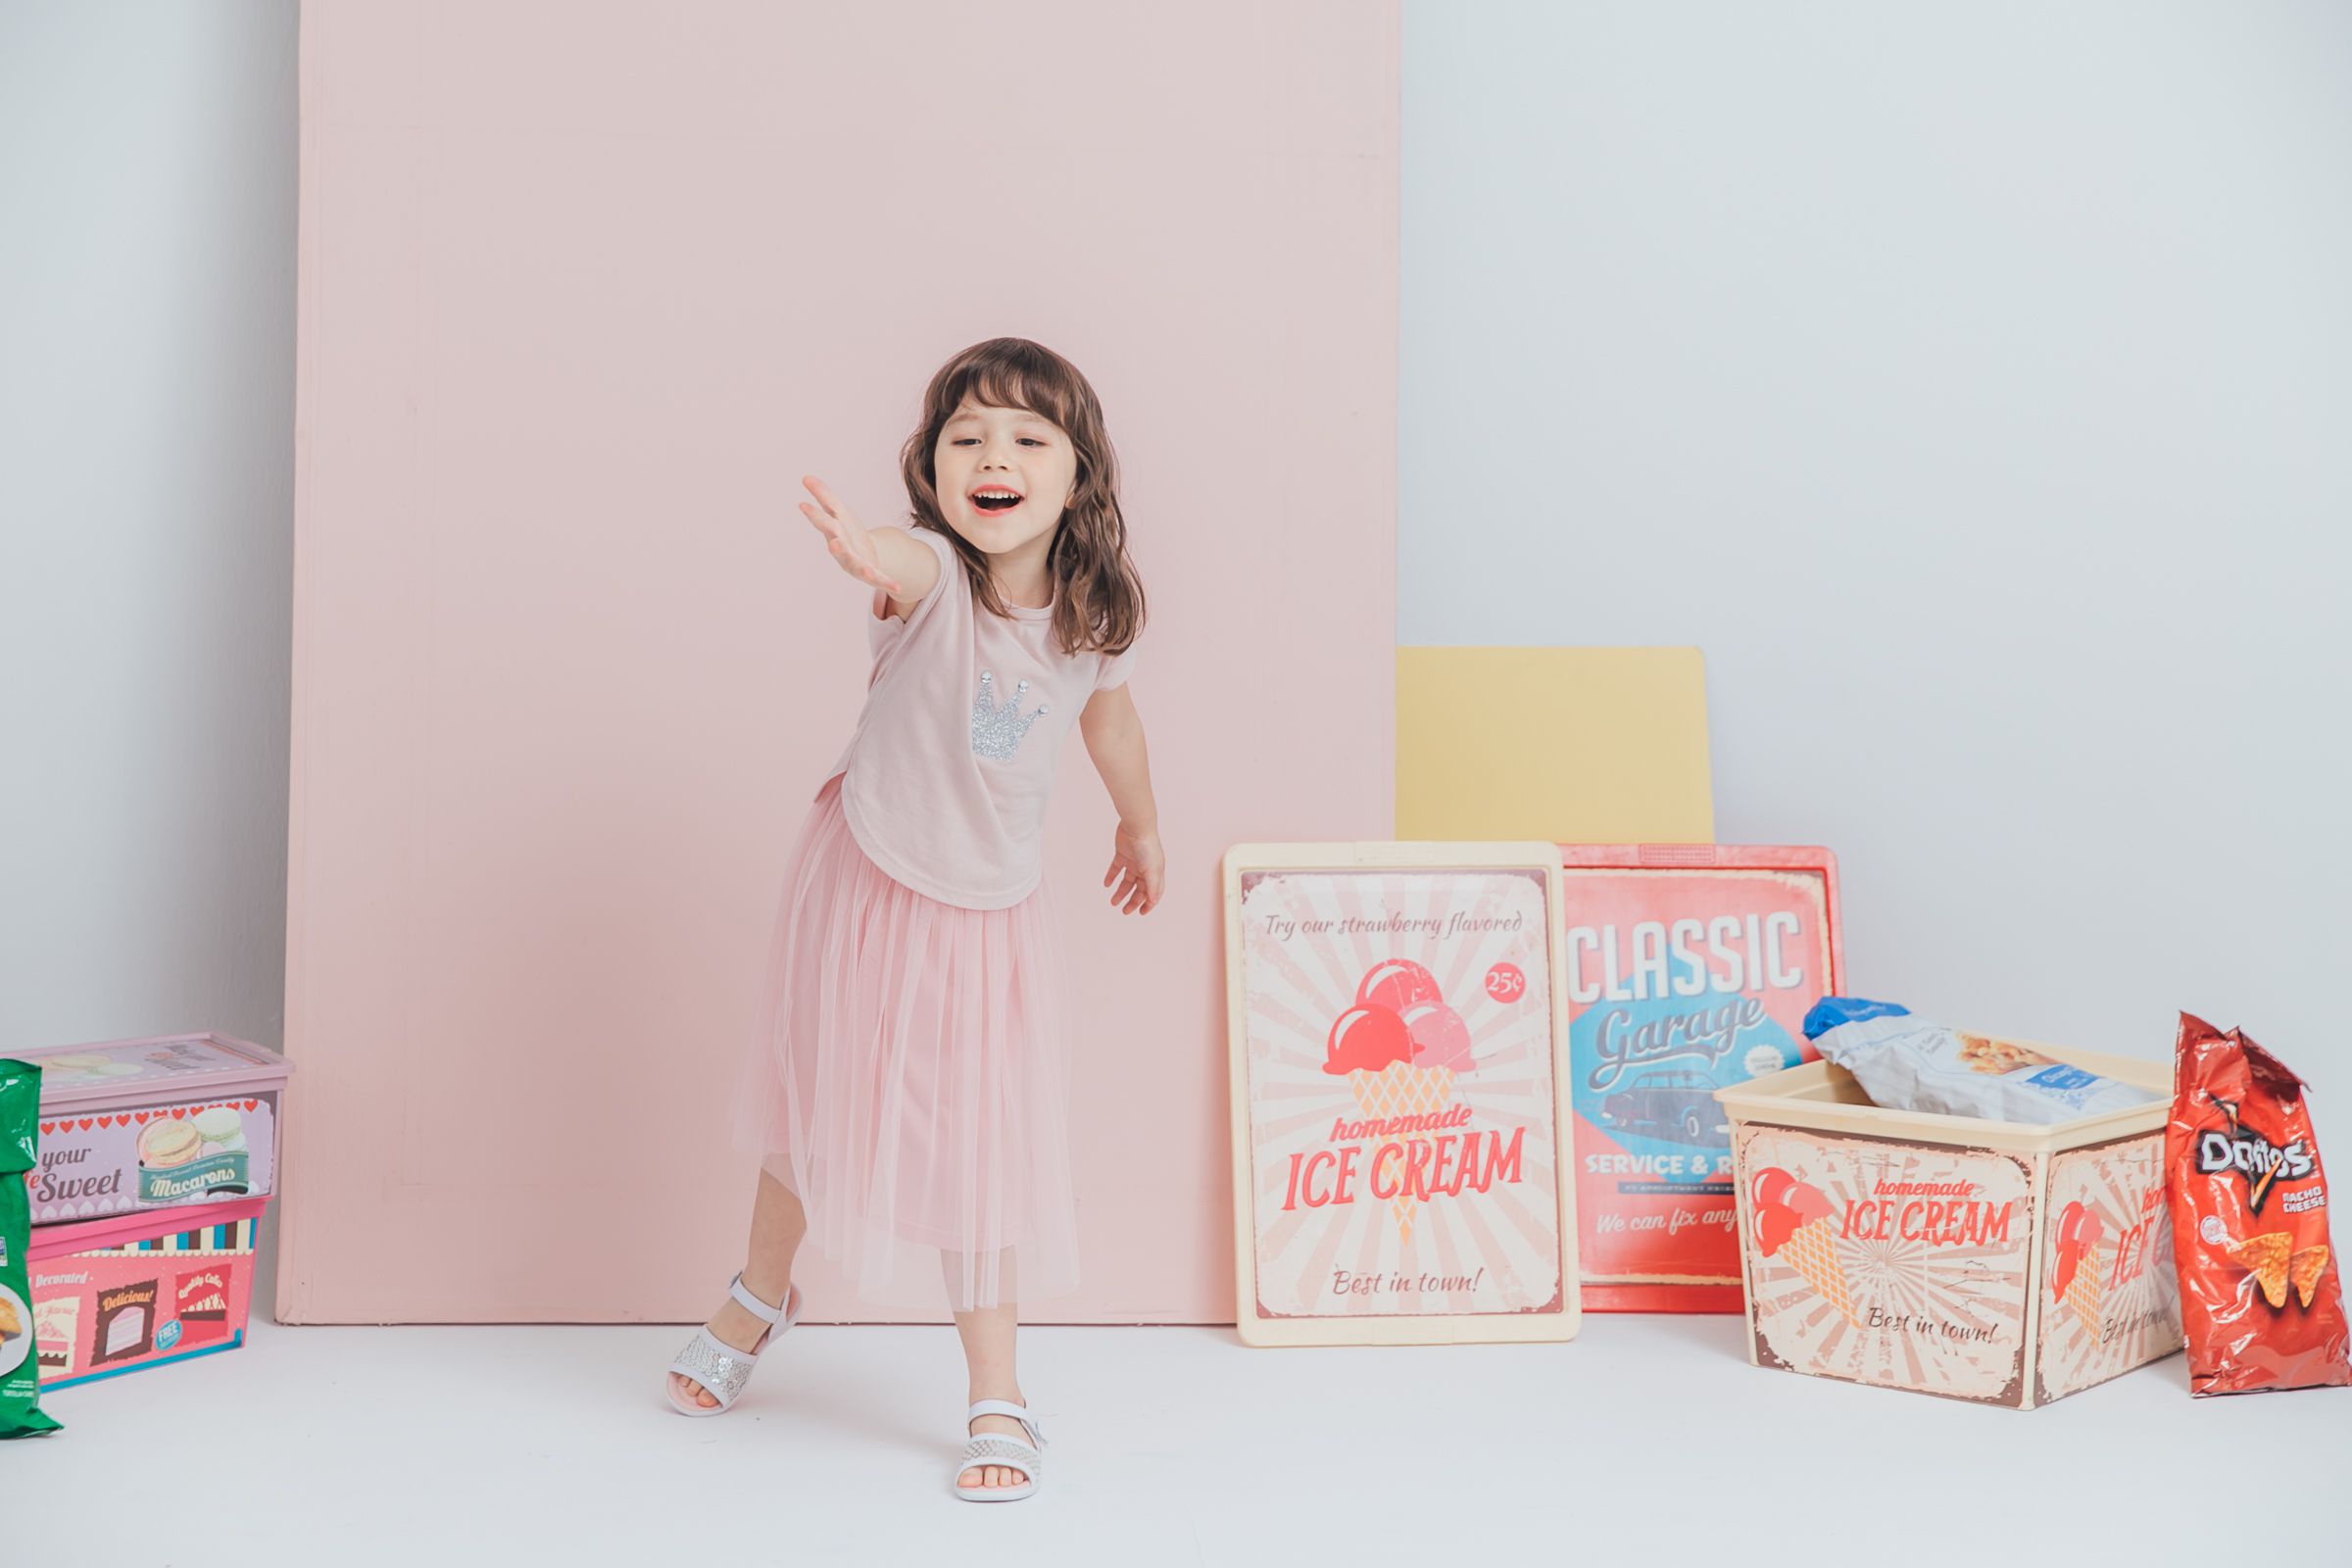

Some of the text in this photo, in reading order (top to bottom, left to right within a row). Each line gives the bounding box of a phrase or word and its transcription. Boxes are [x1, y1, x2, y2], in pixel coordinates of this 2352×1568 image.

[1265, 910, 1524, 942] Try our strawberry flavored
[1568, 911, 1802, 1004] CLASSIC
[1487, 969, 1523, 995] 25¢
[1588, 998, 1767, 1092] Garage
[1329, 1103, 1474, 1143] homemade
[42, 1148, 92, 1173] your
[1281, 1127, 1526, 1211] ICE CREAM
[1584, 1153, 1685, 1175] SERVICE
[1690, 1154, 1709, 1175] &
[2201, 1133, 2315, 1178] Doritos
[36, 1168, 122, 1202] Sweet
[150, 1168, 235, 1198] Macarons
[1873, 1178, 1976, 1197] homemade
[2281, 1186, 2323, 1202] NACHO
[2282, 1195, 2328, 1213] CHEESE
[1596, 1212, 1627, 1234] We
[1630, 1215, 1668, 1231] can
[1668, 1207, 1698, 1236] fix
[1840, 1200, 2013, 1248] ICE CREAM
[2108, 1216, 2154, 1291] ICE
[35, 1271, 88, 1289] Decorated
[1332, 1267, 1485, 1296] Best in town!
[102, 1289, 154, 1312] Delicious!
[158, 1320, 179, 1343] FREE
[1868, 1306, 1998, 1344] Best in town!
